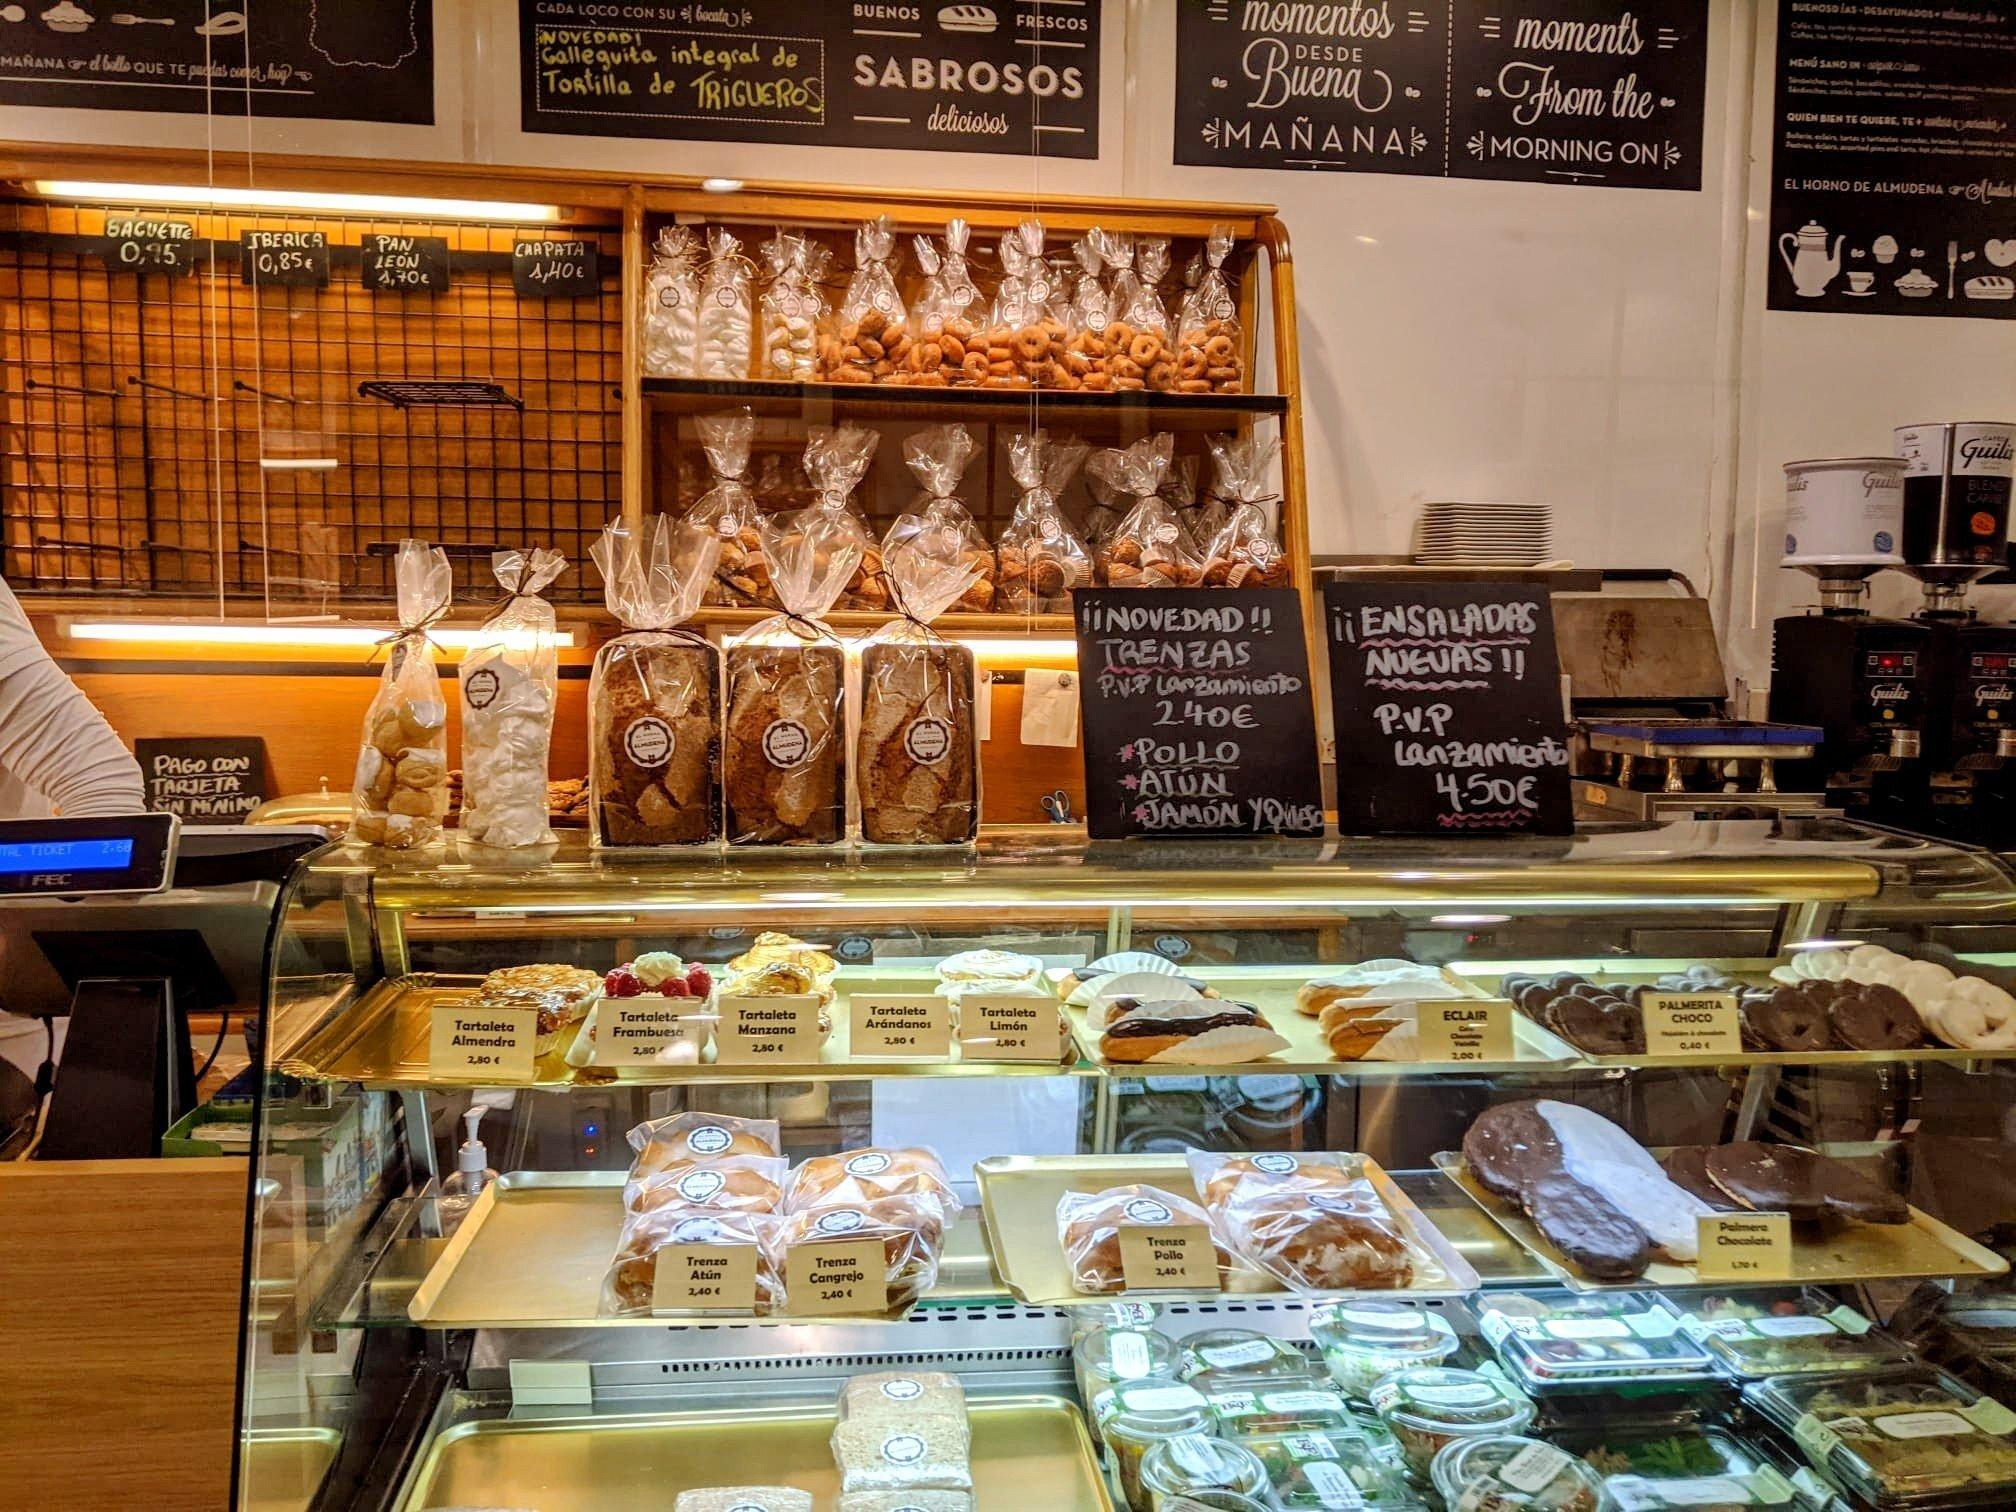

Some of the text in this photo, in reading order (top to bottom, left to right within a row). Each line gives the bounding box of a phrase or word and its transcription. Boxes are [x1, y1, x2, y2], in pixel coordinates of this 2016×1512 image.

[536, 3, 574, 14] CADA
[579, 5, 618, 17] LOCO
[623, 7, 655, 18] CON
[659, 9, 676, 20] SU
[853, 4, 920, 20] BUENOS
[1016, 14, 1088, 31] FRESCOS
[1241, 0, 1395, 38] momentos
[1513, 12, 1644, 56] moments
[672, 40, 760, 72] integral
[772, 45, 798, 68] de
[1296, 45, 1363, 62] DESDE
[135, 62, 164, 74] QUE
[171, 64, 186, 76] TE
[1242, 38, 1393, 112] Buena
[543, 67, 632, 95] Tortilla
[649, 72, 676, 94] de
[854, 54, 1084, 99] SABROSOS
[1498, 61, 1655, 125] From the
[927, 103, 1010, 134] deliciosos
[1786, 112, 1819, 122] QUIEN
[1820, 114, 1843, 123] BIEN
[1845, 115, 1858, 124] TE
[1225, 116, 1404, 155] MAÑANA
[1490, 136, 1659, 165] MORNING ON
[1784, 178, 1944, 195] EL HORNO DE ALMUDENA
[376, 235, 415, 253] PAN
[515, 242, 586, 258] CHAPATA
[1361, 602, 1539, 637] ENSALADAS
[1096, 638, 1252, 669] TRENZAS
[1134, 738, 1241, 765] POLLO
[154, 755, 208, 775] PAGO
[151, 777, 242, 796] TARJETA
[1138, 768, 1228, 796] ATÚN
[1146, 799, 1241, 829] JAMÓN
[31, 843, 74, 856] TICKET
[870, 1006, 927, 1017] Tartaleta
[1658, 1000, 1724, 1010] PALMERITA
[620, 1011, 679, 1022] Tartaleta
[738, 1010, 797, 1021] Tartaleta
[980, 1007, 1037, 1018] Tartaleta
[1443, 1010, 1487, 1021] ECLAIR
[1671, 1013, 1713, 1023] CHOCO
[455, 1020, 515, 1033] Tartaleta
[738, 1024, 796, 1035] Manzana
[865, 1018, 932, 1030] Arándanos
[989, 1020, 1028, 1032] Limón
[613, 1026, 684, 1038] Frambuesa
[451, 1035, 516, 1048] Almendra
[884, 1036, 916, 1046] 2,80 €
[752, 1043, 775, 1053] 2,80
[467, 1055, 501, 1066] 2,80 €
[1719, 1221, 1769, 1232] Palmera
[1147, 1237, 1186, 1247] Trenza
[1717, 1235, 1773, 1246] Chocolate
[686, 1256, 728, 1267] Trenza
[816, 1256, 857, 1269] Trenza
[1154, 1250, 1184, 1262] Pollo
[690, 1268, 722, 1281] Atún
[809, 1270, 865, 1285] Cangrejo
[688, 1286, 721, 1297] 2,40 €
[821, 1288, 853, 1300] 2,40 €
